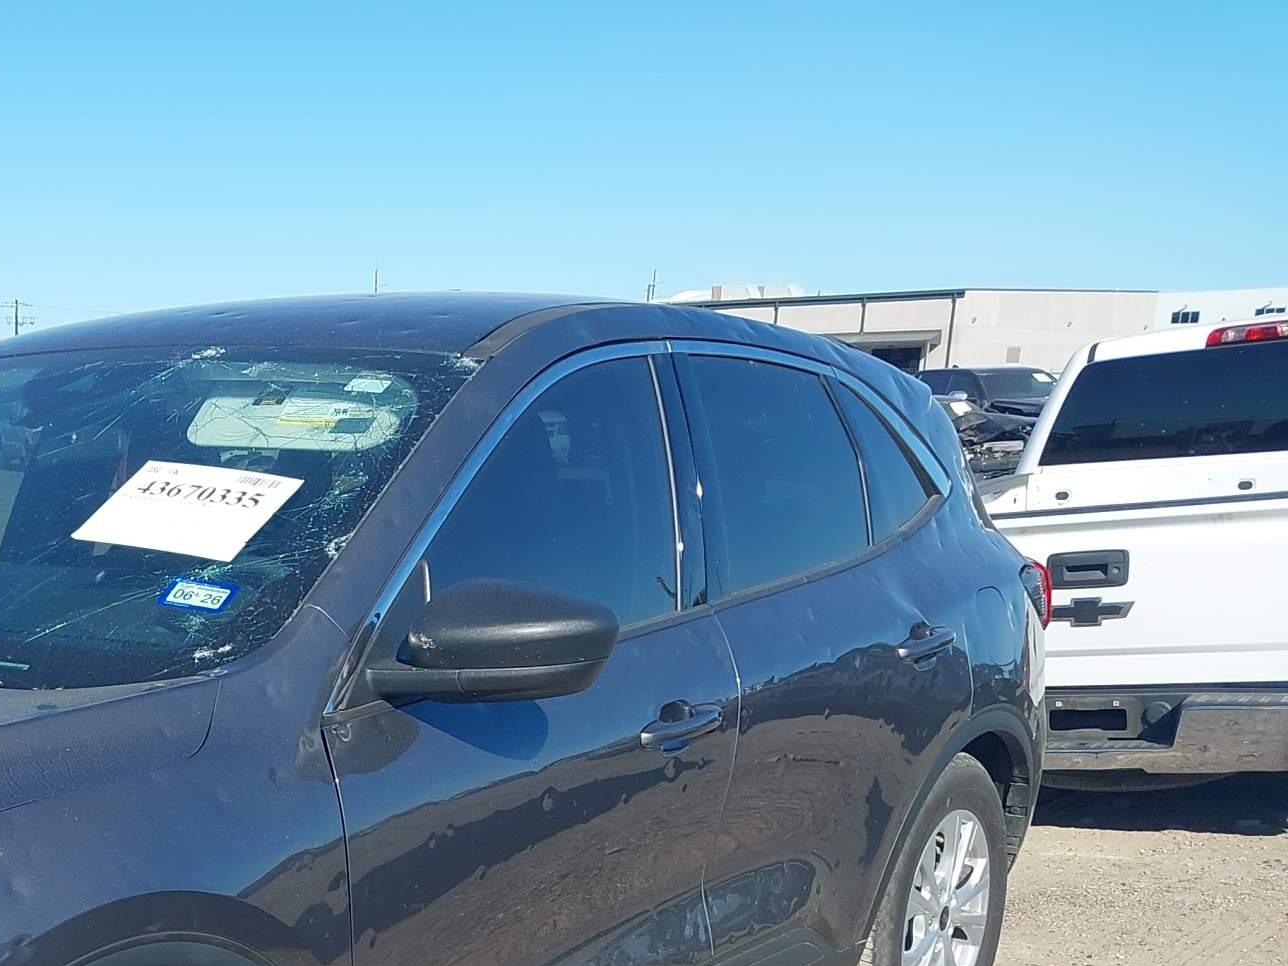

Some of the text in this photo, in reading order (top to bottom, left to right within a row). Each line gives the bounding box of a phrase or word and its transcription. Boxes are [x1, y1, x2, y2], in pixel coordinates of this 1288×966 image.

[138, 480, 265, 509] 43670335
[172, 588, 195, 601] 06
[199, 593, 223, 606] 26
